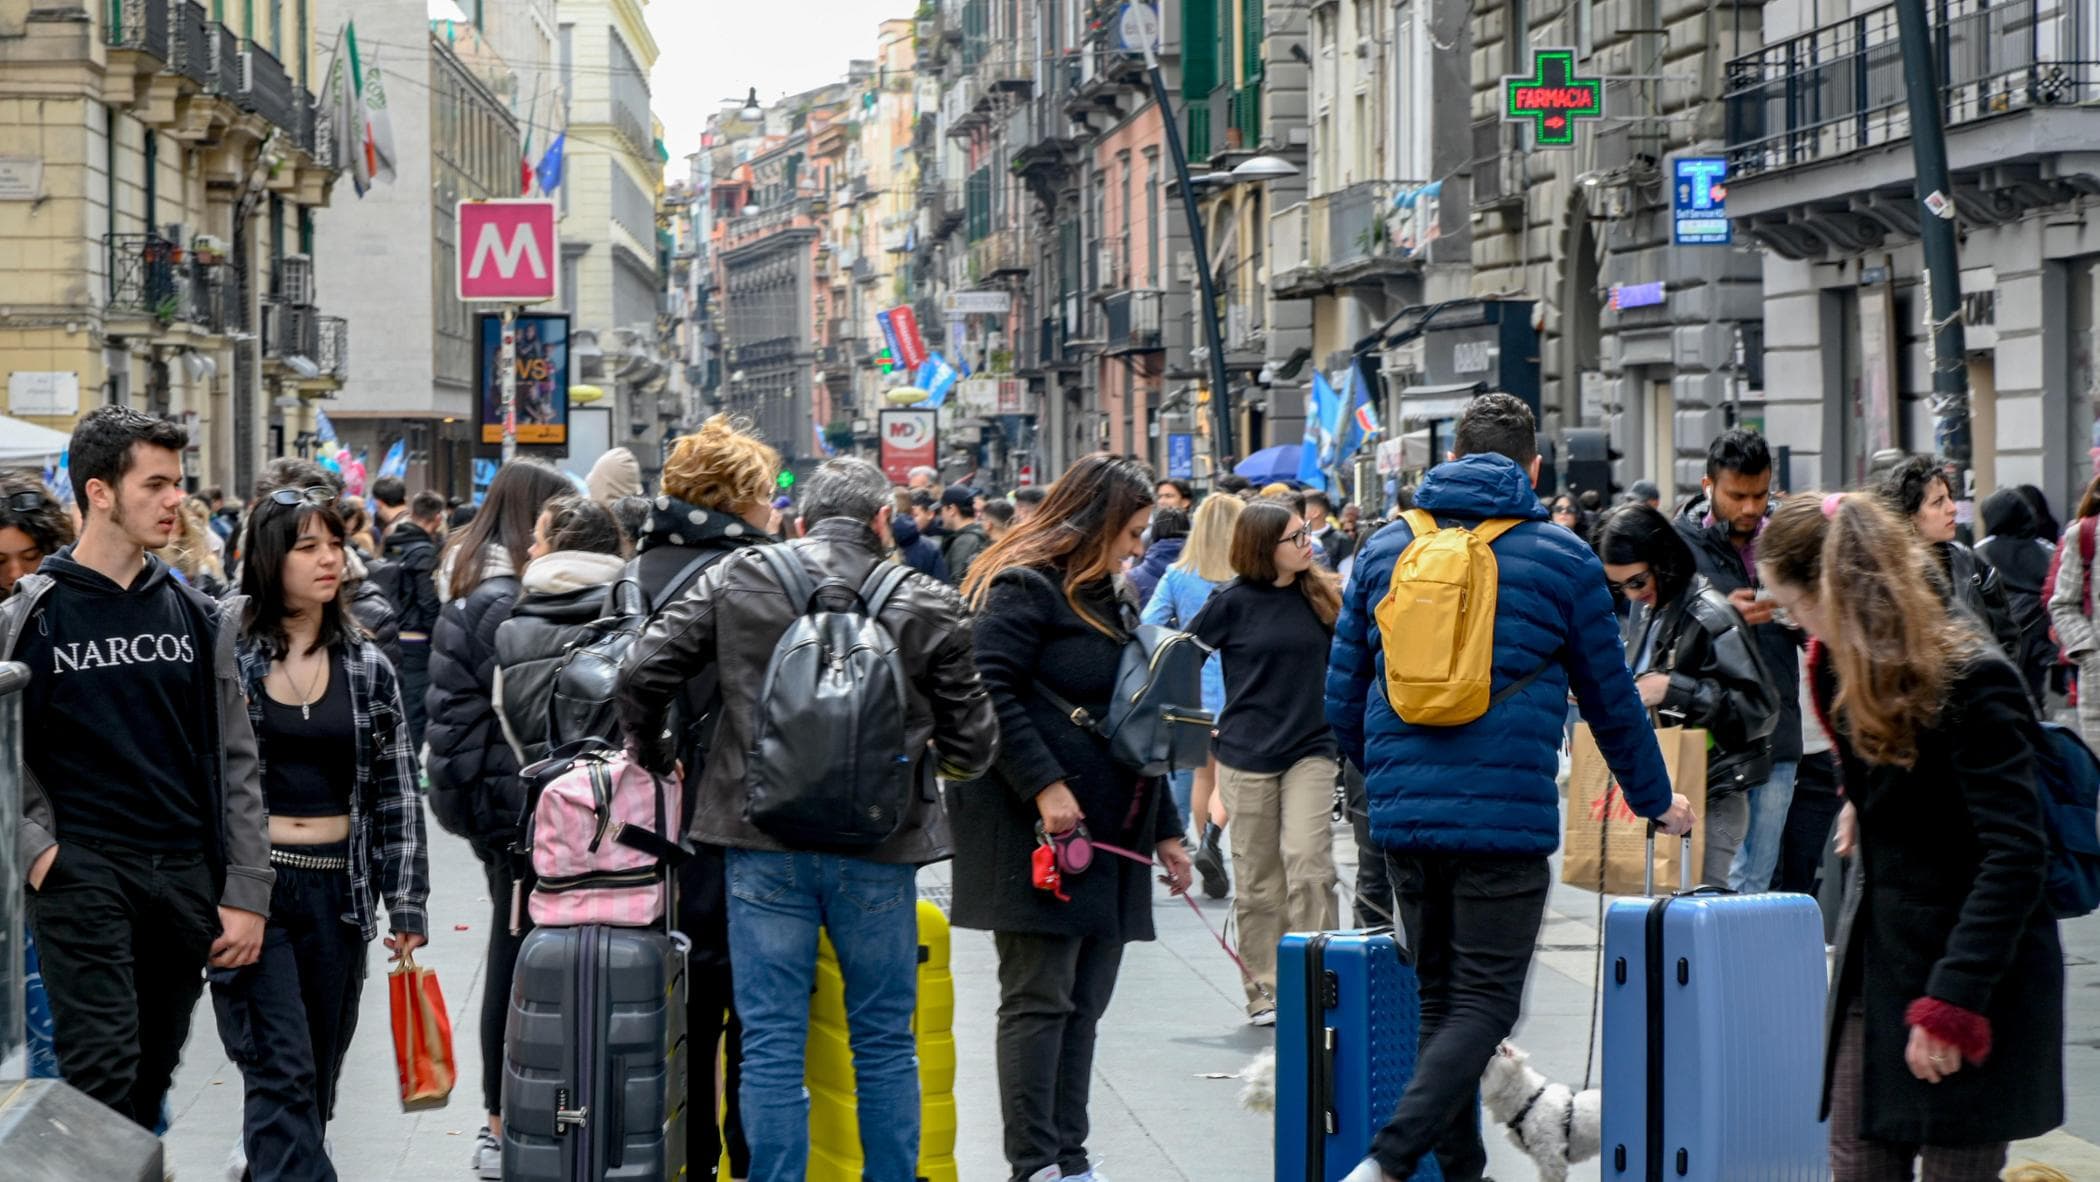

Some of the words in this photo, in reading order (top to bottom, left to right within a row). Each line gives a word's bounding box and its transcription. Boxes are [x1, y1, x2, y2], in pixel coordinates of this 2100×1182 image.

[1516, 88, 1592, 108] FARMACIA
[1678, 161, 1726, 208] T
[467, 222, 547, 279] M
[54, 634, 194, 674] NARCOS
